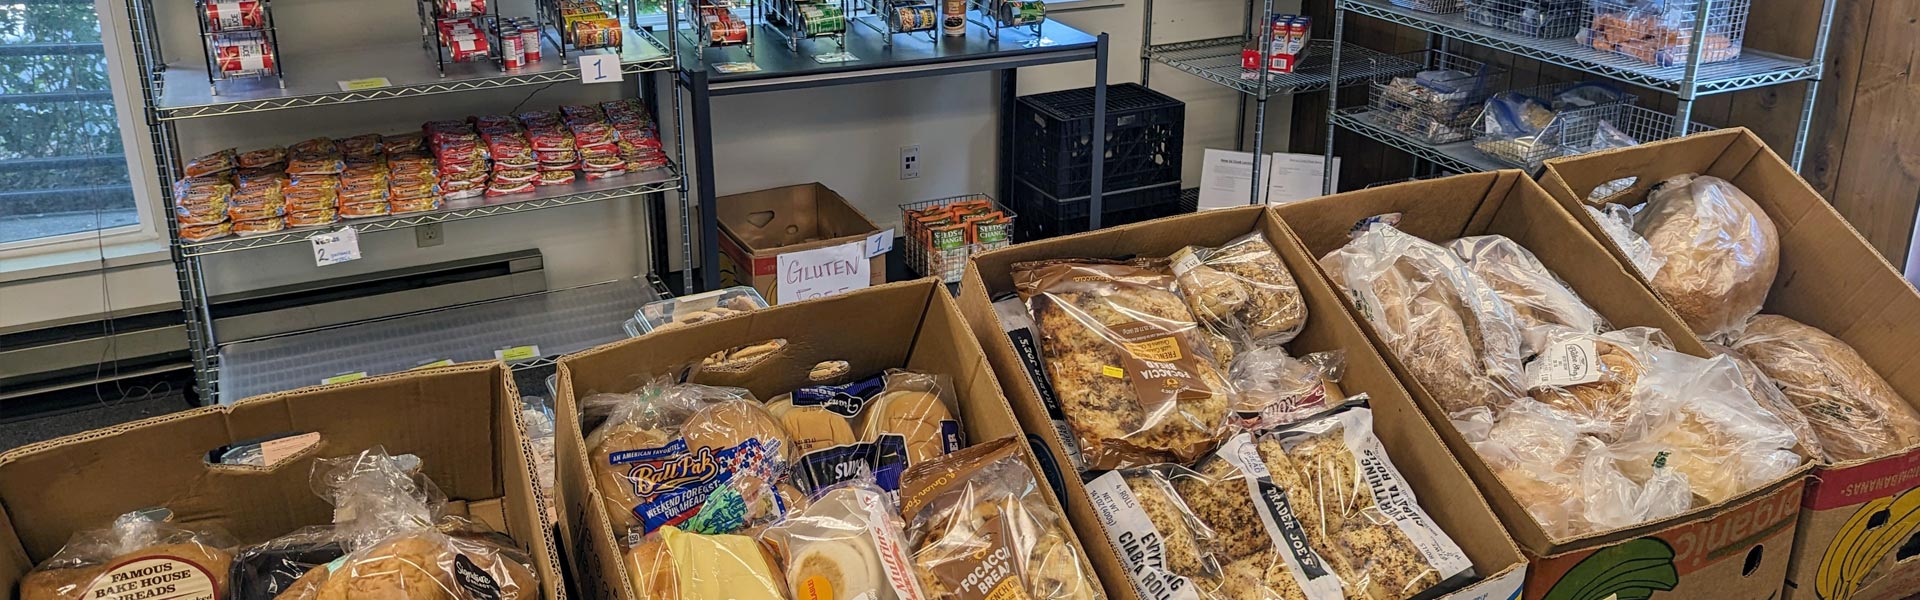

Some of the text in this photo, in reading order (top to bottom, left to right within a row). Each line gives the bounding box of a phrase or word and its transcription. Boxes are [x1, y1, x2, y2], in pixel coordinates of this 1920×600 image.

[593, 58, 607, 80] 1
[980, 223, 1003, 233] SEEDS
[318, 248, 329, 262] 2
[786, 256, 860, 285] GLUTEN
[1021, 338, 1056, 410] TRADER JOE'S
[1140, 369, 1191, 379] FOCACCIA
[1146, 361, 1177, 370] BREAD
[622, 451, 651, 460] AMERICAN
[1364, 449, 1392, 481] ROLLS
[633, 450, 716, 494] Ball Pak
[1102, 492, 1113, 504] NET
[1361, 459, 1407, 522] EVERYTHING
[646, 496, 680, 519] WEEKEND
[1267, 486, 1317, 569] TRADER JOE'S
[875, 527, 908, 594] Muffins
[111, 562, 173, 583] FAMOUS
[95, 570, 191, 599] BAKE HOUSE
